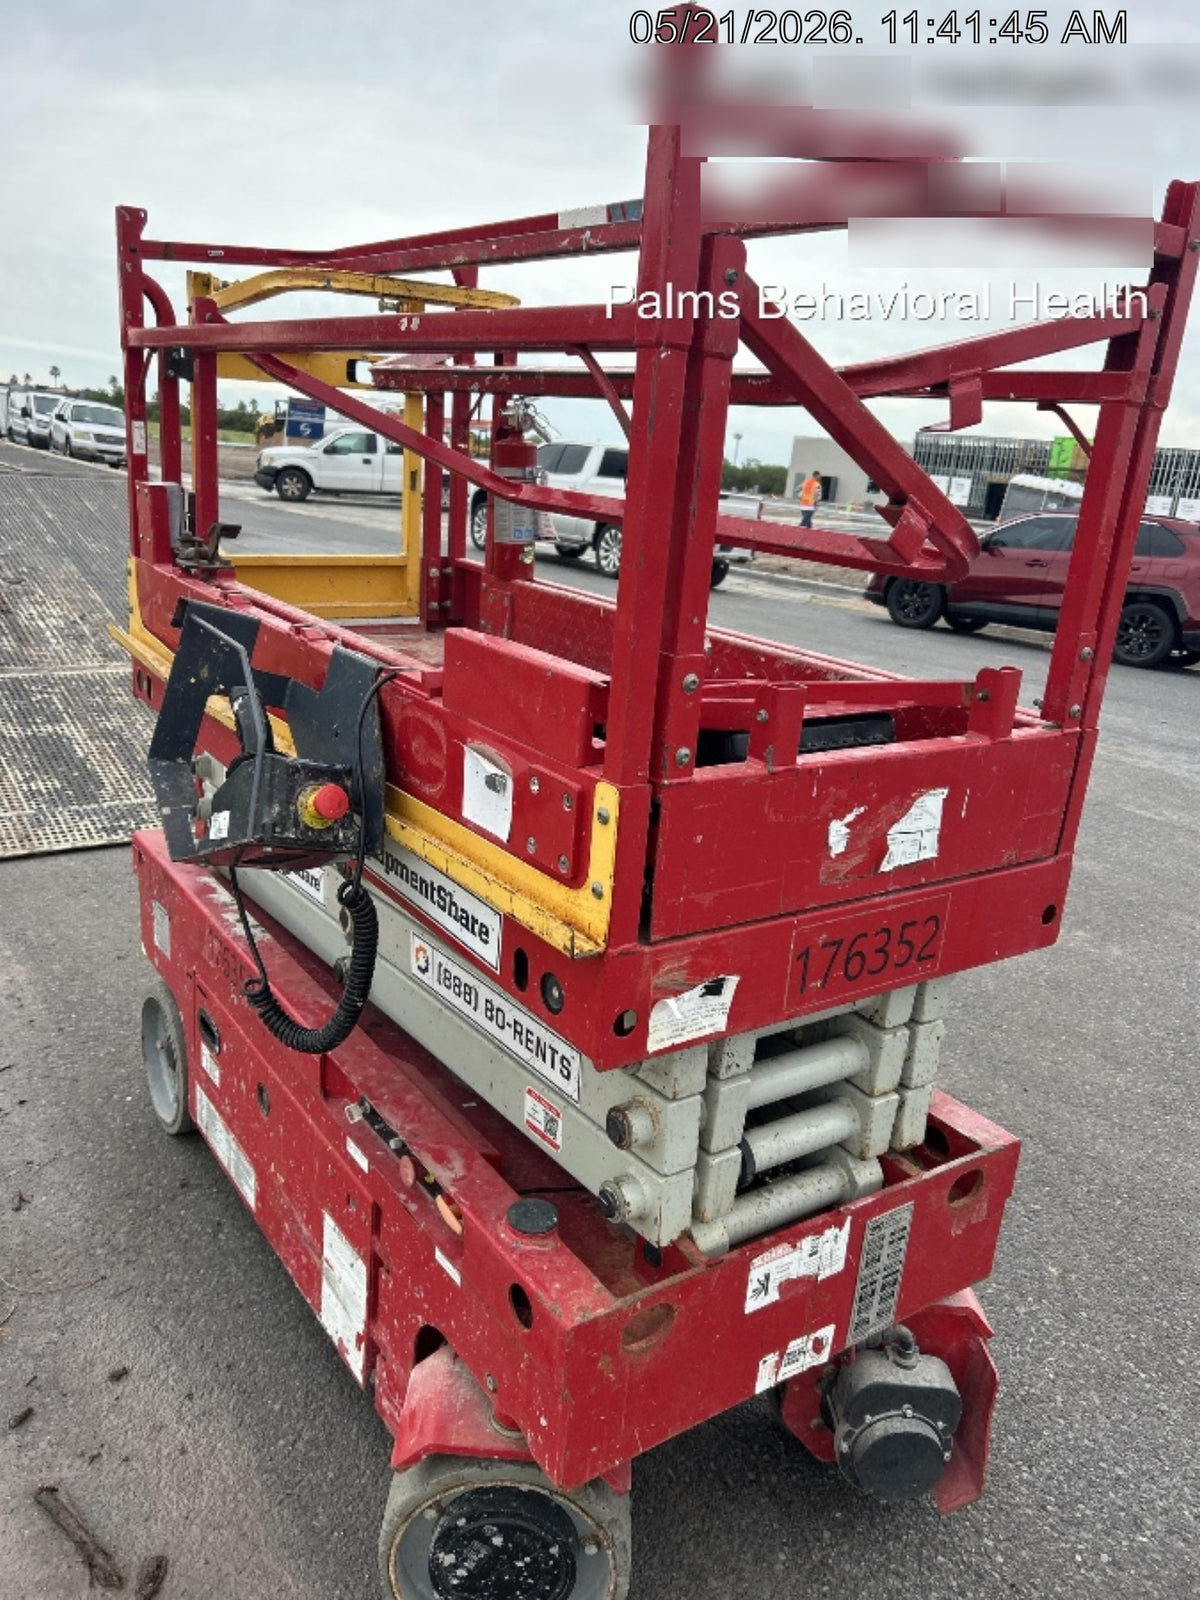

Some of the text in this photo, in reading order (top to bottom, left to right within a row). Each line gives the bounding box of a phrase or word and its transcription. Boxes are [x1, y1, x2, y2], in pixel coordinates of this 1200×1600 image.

[796, 914, 940, 994] 176352
[436, 961, 479, 1013] (888)
[484, 998, 572, 1082] 80-RENTS
